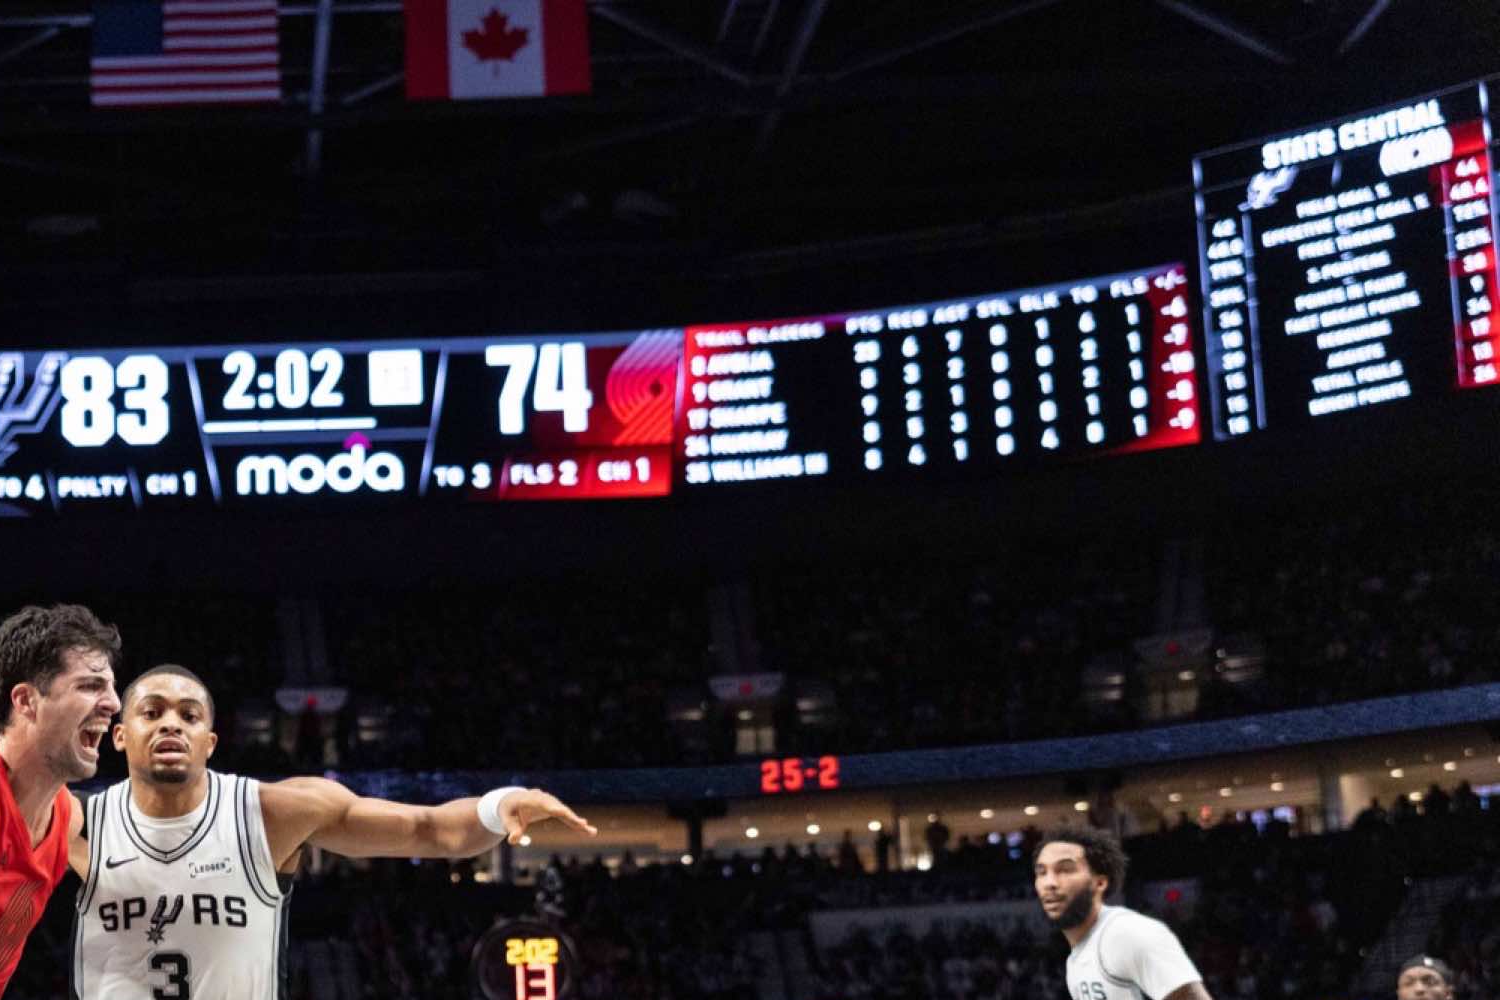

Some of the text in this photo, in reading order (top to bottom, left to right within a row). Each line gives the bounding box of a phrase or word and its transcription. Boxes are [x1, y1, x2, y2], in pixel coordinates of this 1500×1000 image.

[1262, 127, 1337, 170] STATS
[1338, 99, 1446, 151] CENTRAL
[60, 353, 169, 448] 83
[222, 348, 345, 410] 2:02
[485, 342, 593, 436] 74
[57, 476, 127, 498] PNLTY
[183, 470, 197, 497] 1
[237, 442, 404, 495] moda
[430, 462, 491, 489] TO 3
[510, 460, 578, 487] FLS 2
[635, 456, 650, 482] 1
[98, 893, 248, 939] SPURS
